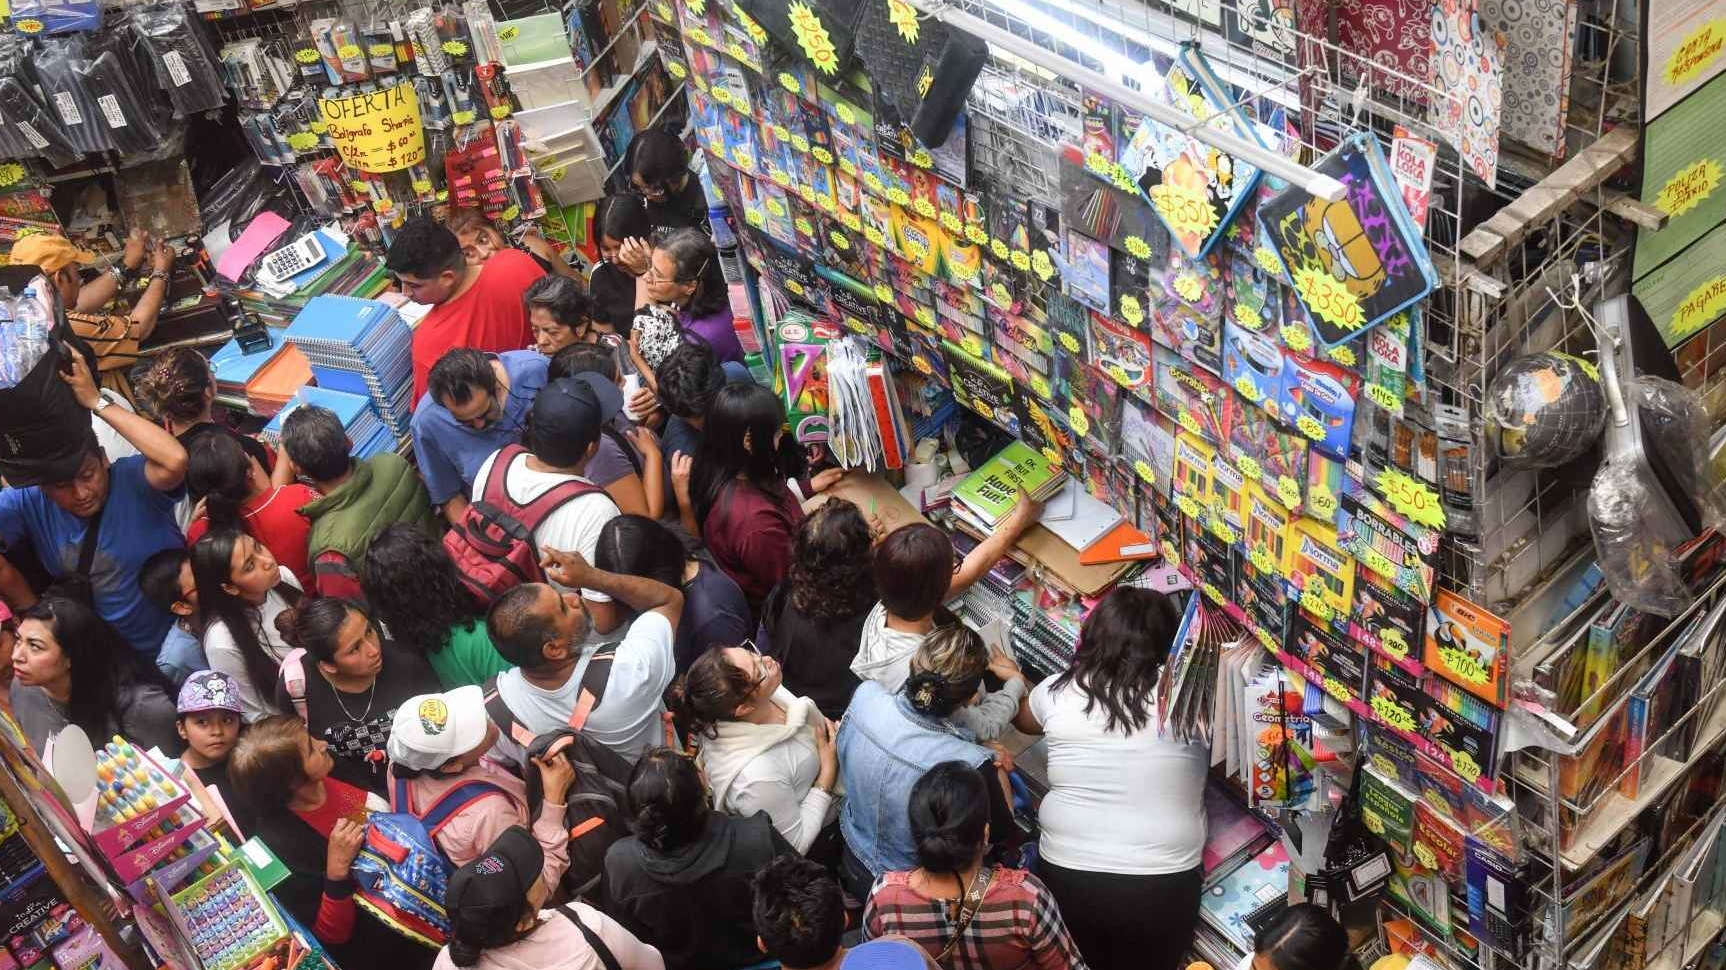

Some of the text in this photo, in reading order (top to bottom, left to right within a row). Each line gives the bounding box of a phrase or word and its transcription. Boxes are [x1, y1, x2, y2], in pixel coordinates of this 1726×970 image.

[325, 86, 406, 119] OFERTA
[1396, 158, 1425, 181] LOKA
[1397, 146, 1425, 169] KOLA
[1160, 193, 1210, 226] $350
[1304, 276, 1357, 324] $350
[1372, 335, 1400, 358] KOLA
[1373, 346, 1400, 366] LOKA
[1014, 463, 1030, 476] BUT
[1213, 453, 1243, 483] Norma
[976, 485, 1008, 504] Fun!
[984, 474, 1017, 496] Have
[1252, 498, 1280, 529] Norma
[1356, 508, 1418, 556] BORRABLES
[1301, 535, 1340, 571] Norma
[1473, 851, 1503, 873] CASIO
[9, 898, 58, 934] CREATIVE
